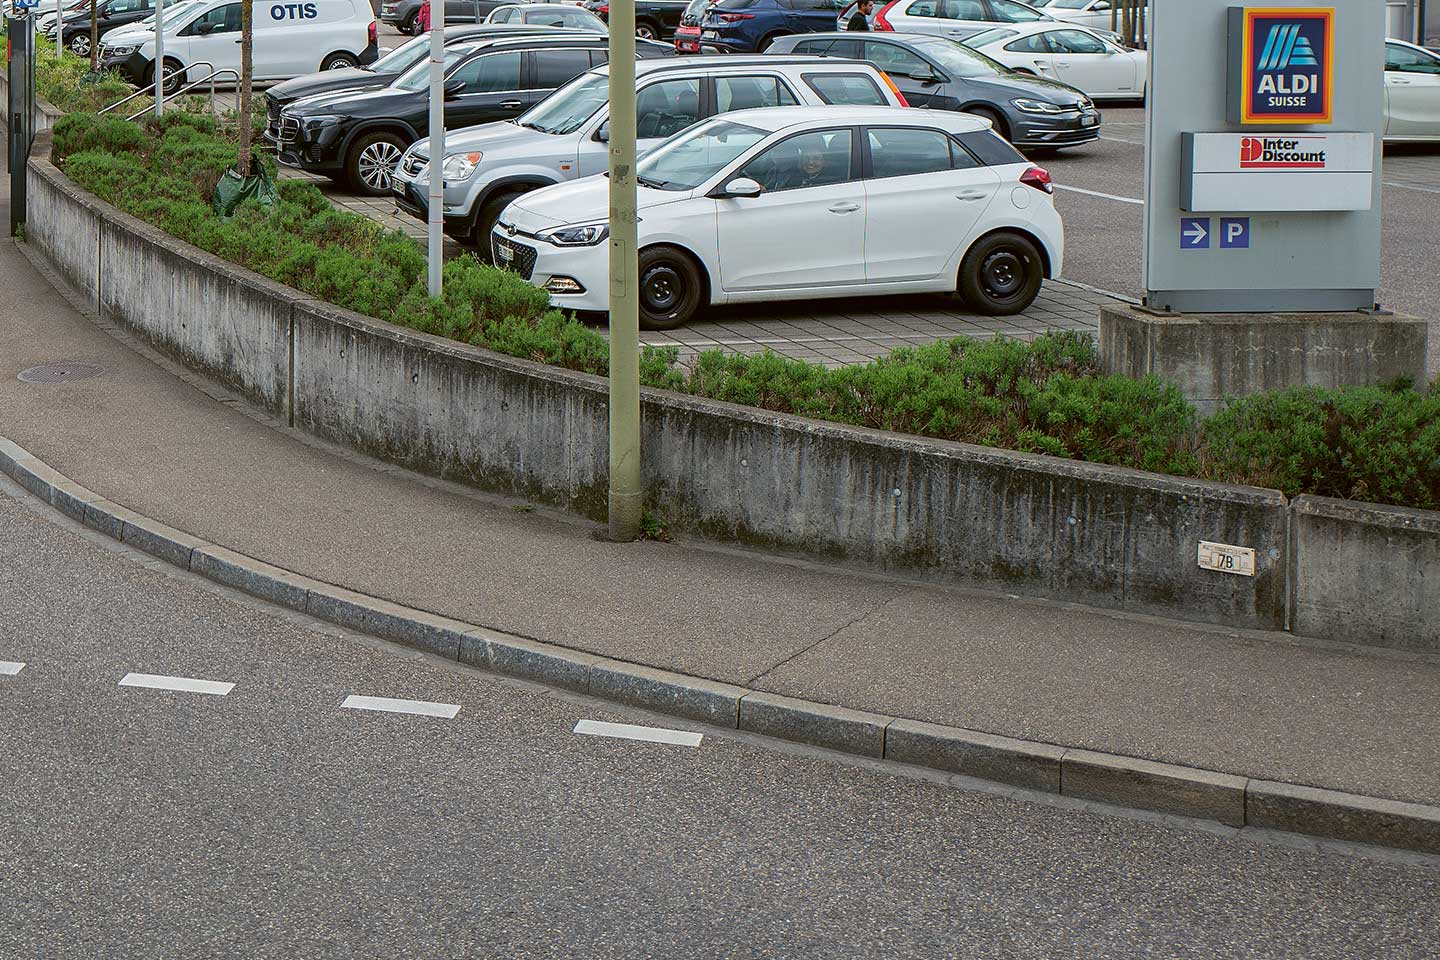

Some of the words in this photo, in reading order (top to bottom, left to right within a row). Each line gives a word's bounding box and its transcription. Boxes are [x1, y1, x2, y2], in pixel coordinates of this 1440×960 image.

[270, 2, 318, 20] OTIS
[1257, 74, 1318, 94] ALDI
[1268, 96, 1306, 106] SUISSE
[1263, 138, 1299, 150] Inter
[1262, 150, 1326, 162] Discount
[1228, 224, 1243, 242] P
[1218, 554, 1233, 568] 7B
